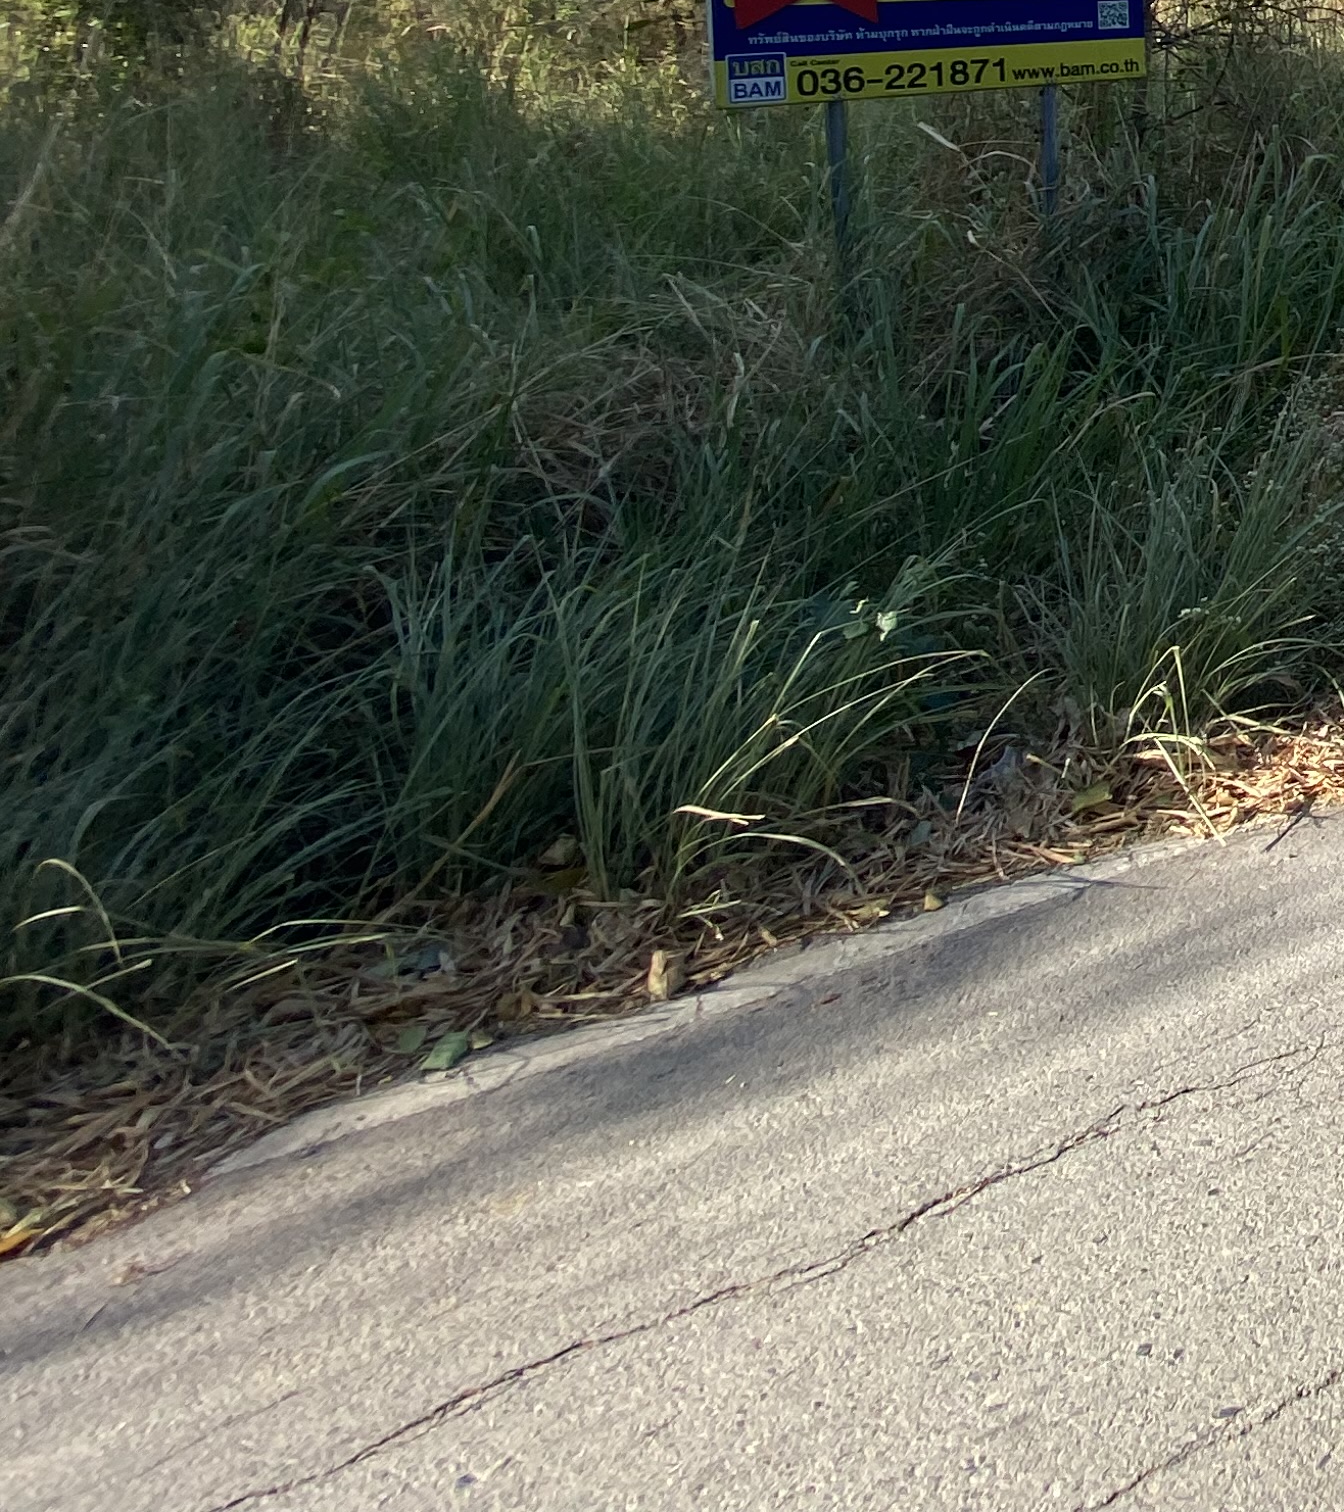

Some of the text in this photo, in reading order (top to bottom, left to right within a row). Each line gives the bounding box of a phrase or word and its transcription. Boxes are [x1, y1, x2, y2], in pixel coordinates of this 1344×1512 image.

[732, 59, 782, 77] บสก
[796, 57, 1007, 97] 036-221871
[1011, 58, 1141, 81] www.bam.co.th
[734, 81, 782, 100] BAM
